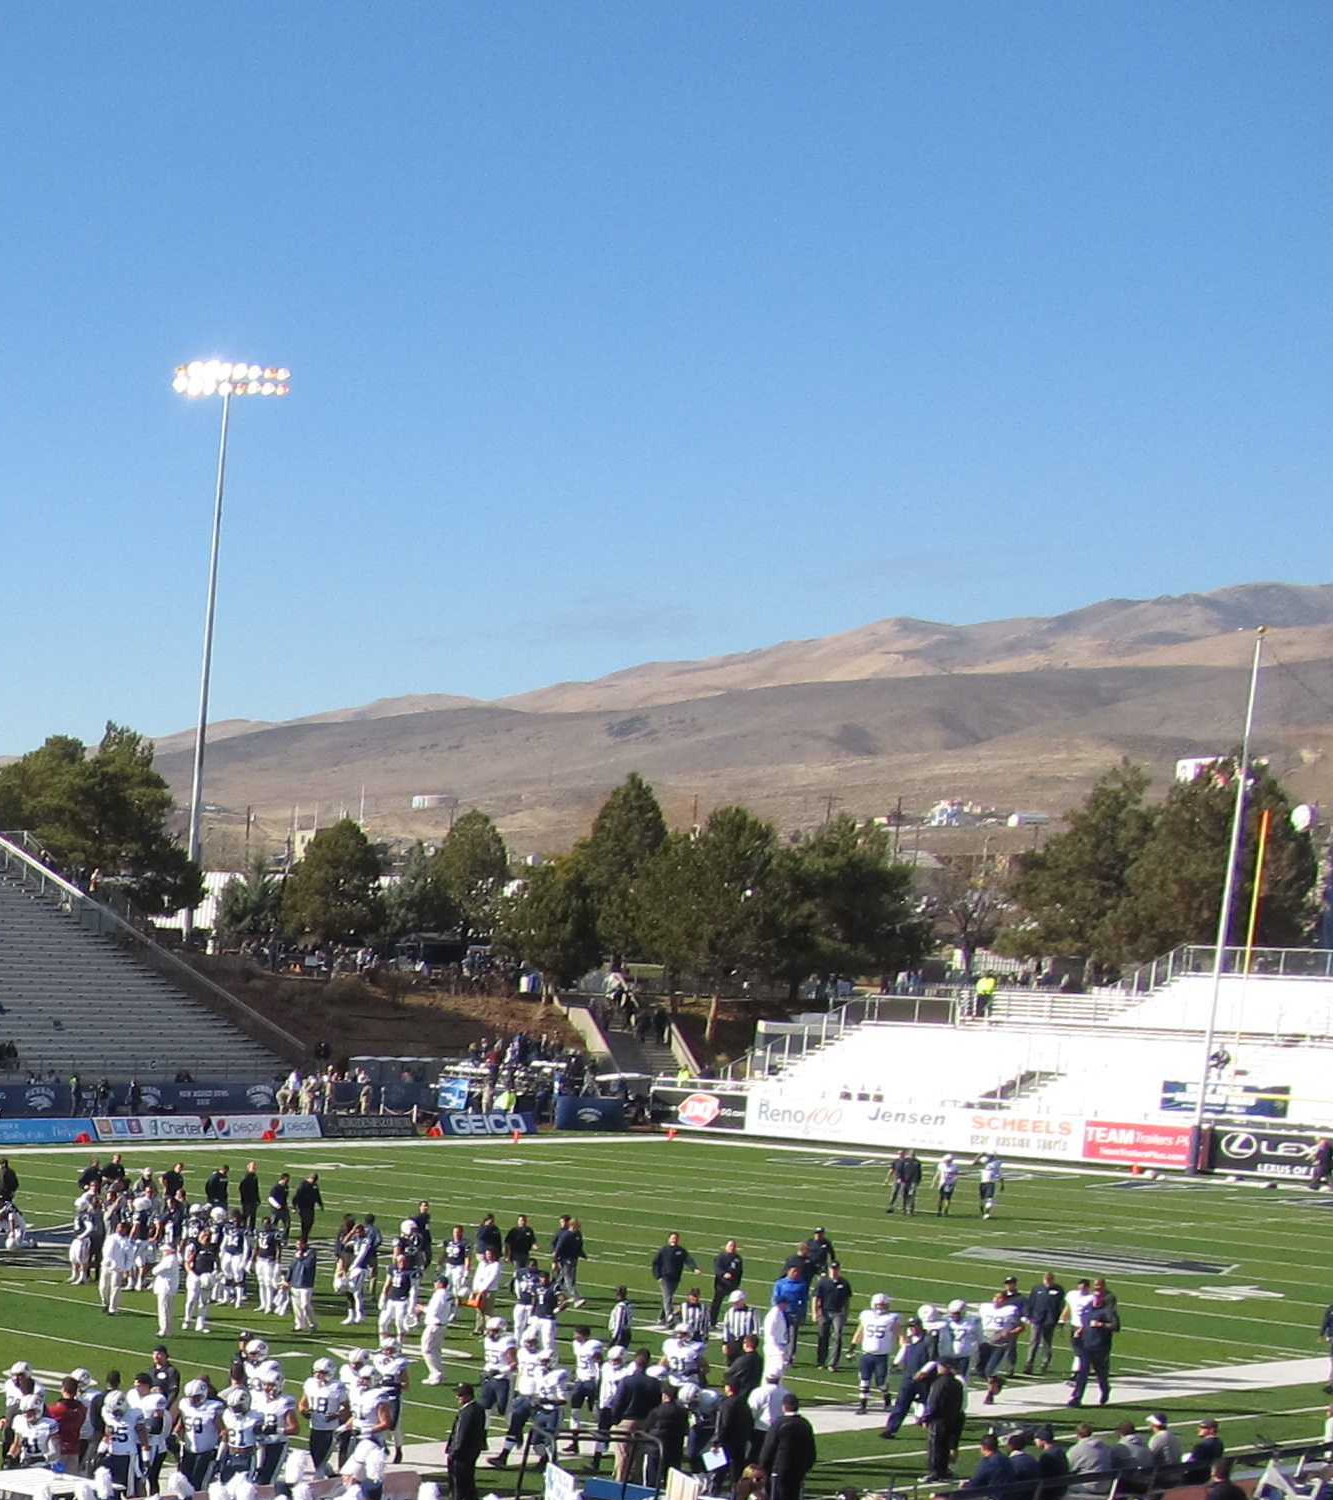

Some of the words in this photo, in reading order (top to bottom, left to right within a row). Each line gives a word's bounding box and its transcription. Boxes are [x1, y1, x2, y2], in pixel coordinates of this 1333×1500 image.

[685, 1100, 713, 1118] DQ
[868, 1106, 946, 1127] Jensen
[161, 1121, 201, 1135] Charter
[232, 1123, 262, 1137] pepsi
[287, 1122, 317, 1136] pepsi
[451, 1113, 528, 1135] GEICO
[971, 1115, 1073, 1136] SCHEELS
[1086, 1125, 1135, 1146] TEAM
[1135, 1131, 1174, 1147] Trailers
[1257, 1162, 1290, 1174] LEXUS
[865, 1324, 886, 1340] 55
